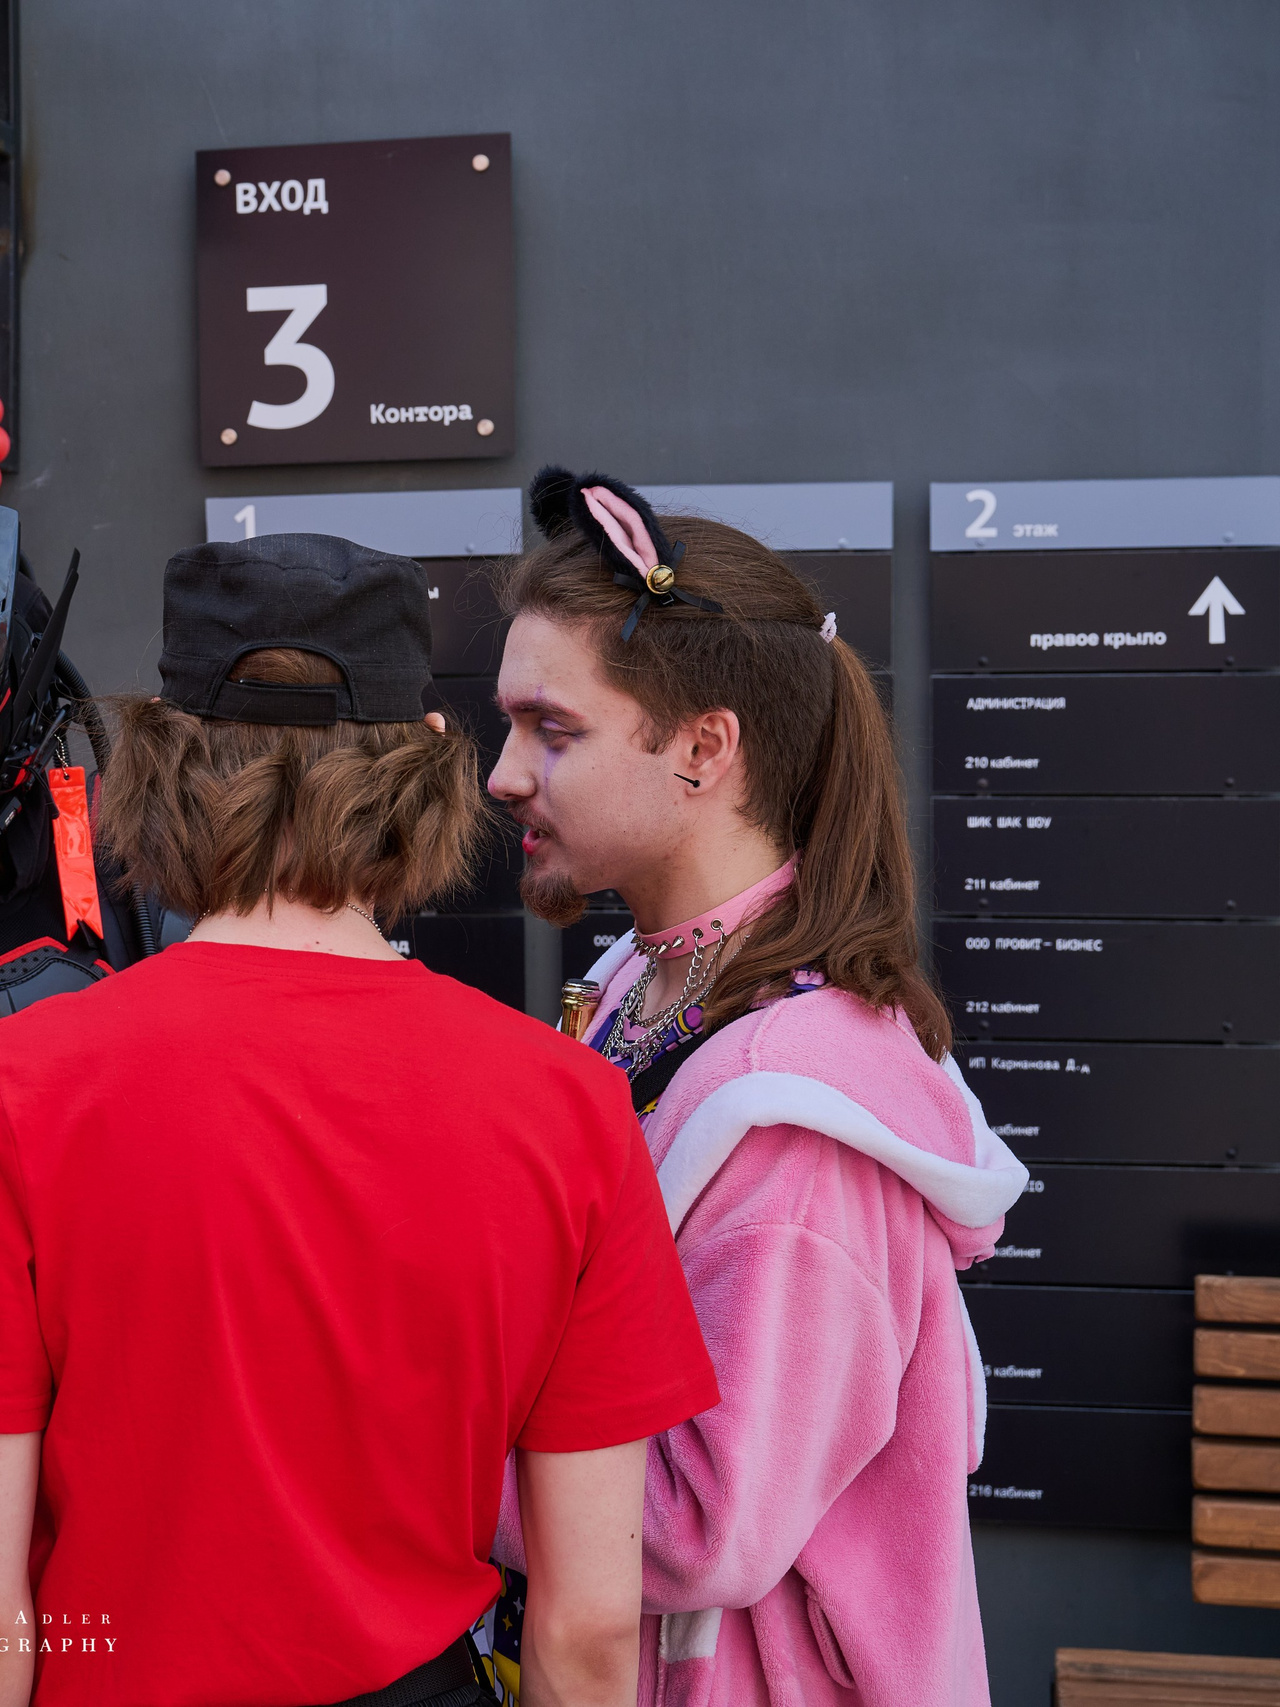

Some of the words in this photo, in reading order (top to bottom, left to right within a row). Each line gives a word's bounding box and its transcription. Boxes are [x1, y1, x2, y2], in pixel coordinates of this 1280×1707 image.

[235, 178, 329, 215] ВХОД
[246, 284, 335, 430] 3
[370, 403, 473, 426] Контора
[965, 489, 998, 538] 2
[1012, 523, 1058, 538] этаж
[1030, 632, 1100, 651] правое
[1103, 631, 1168, 650] крыло
[966, 697, 1066, 711] АДМИНИСТРАЦИЯ
[965, 756, 989, 769] 210
[990, 756, 1040, 769] кабинет
[967, 816, 992, 829] ШИК
[997, 816, 1022, 829] ШАК
[1026, 816, 1052, 829] ШОУ
[964, 878, 987, 891] 211
[989, 878, 1040, 891] кабинет
[965, 937, 991, 950] ООО
[966, 1001, 990, 1013] 212
[990, 1002, 1040, 1014] кабинет
[968, 1057, 986, 1069] ИП
[995, 1246, 1042, 1258] кабинет
[993, 1365, 1042, 1378] кабинет
[968, 1484, 993, 1497] 216
[993, 1486, 1043, 1500] кабинет
